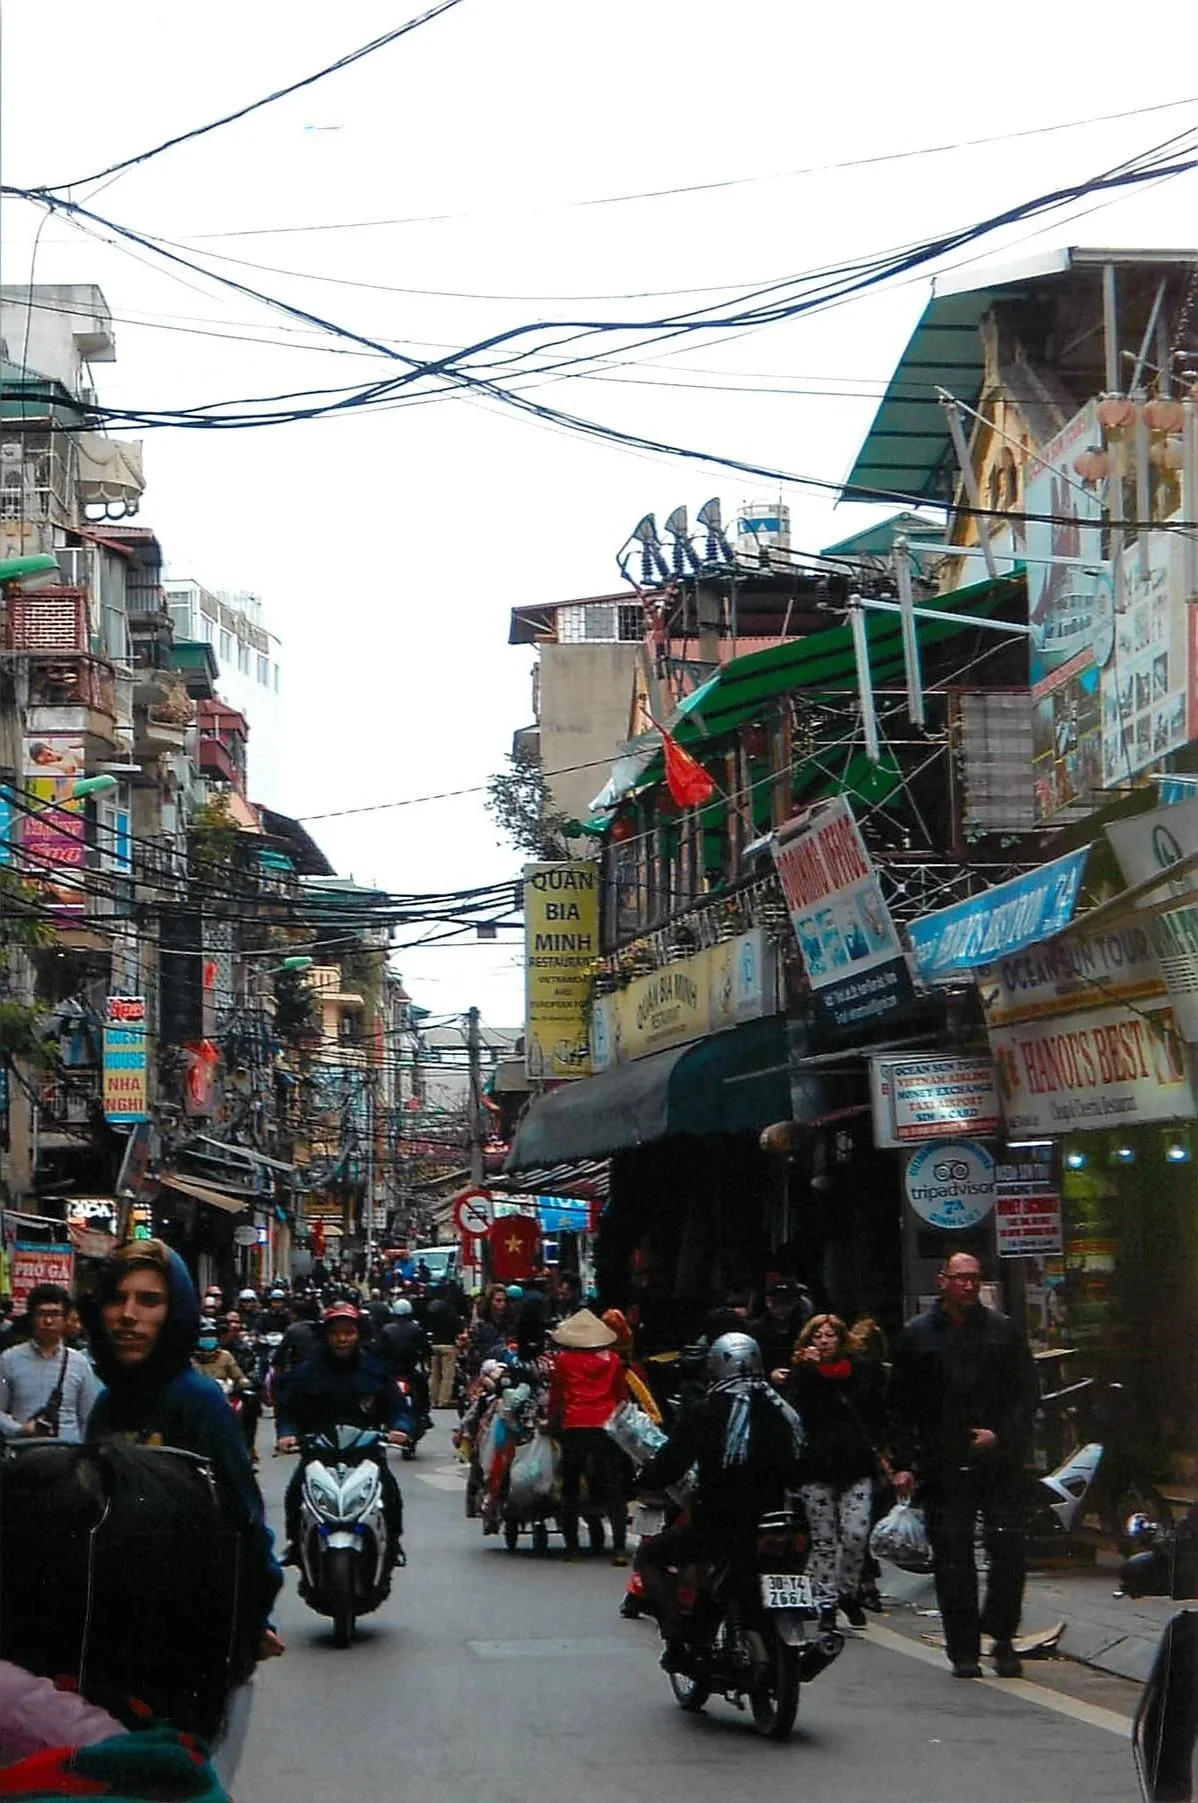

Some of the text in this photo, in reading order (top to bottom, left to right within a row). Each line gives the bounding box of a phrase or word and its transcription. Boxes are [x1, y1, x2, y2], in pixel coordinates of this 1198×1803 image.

[546, 903, 580, 920] BIA
[535, 933, 592, 951] MINH
[105, 1051, 145, 1069] HOUSE
[1020, 1020, 1149, 1095] HANOI'S BEST
[911, 1181, 994, 1201] tripadvisor
